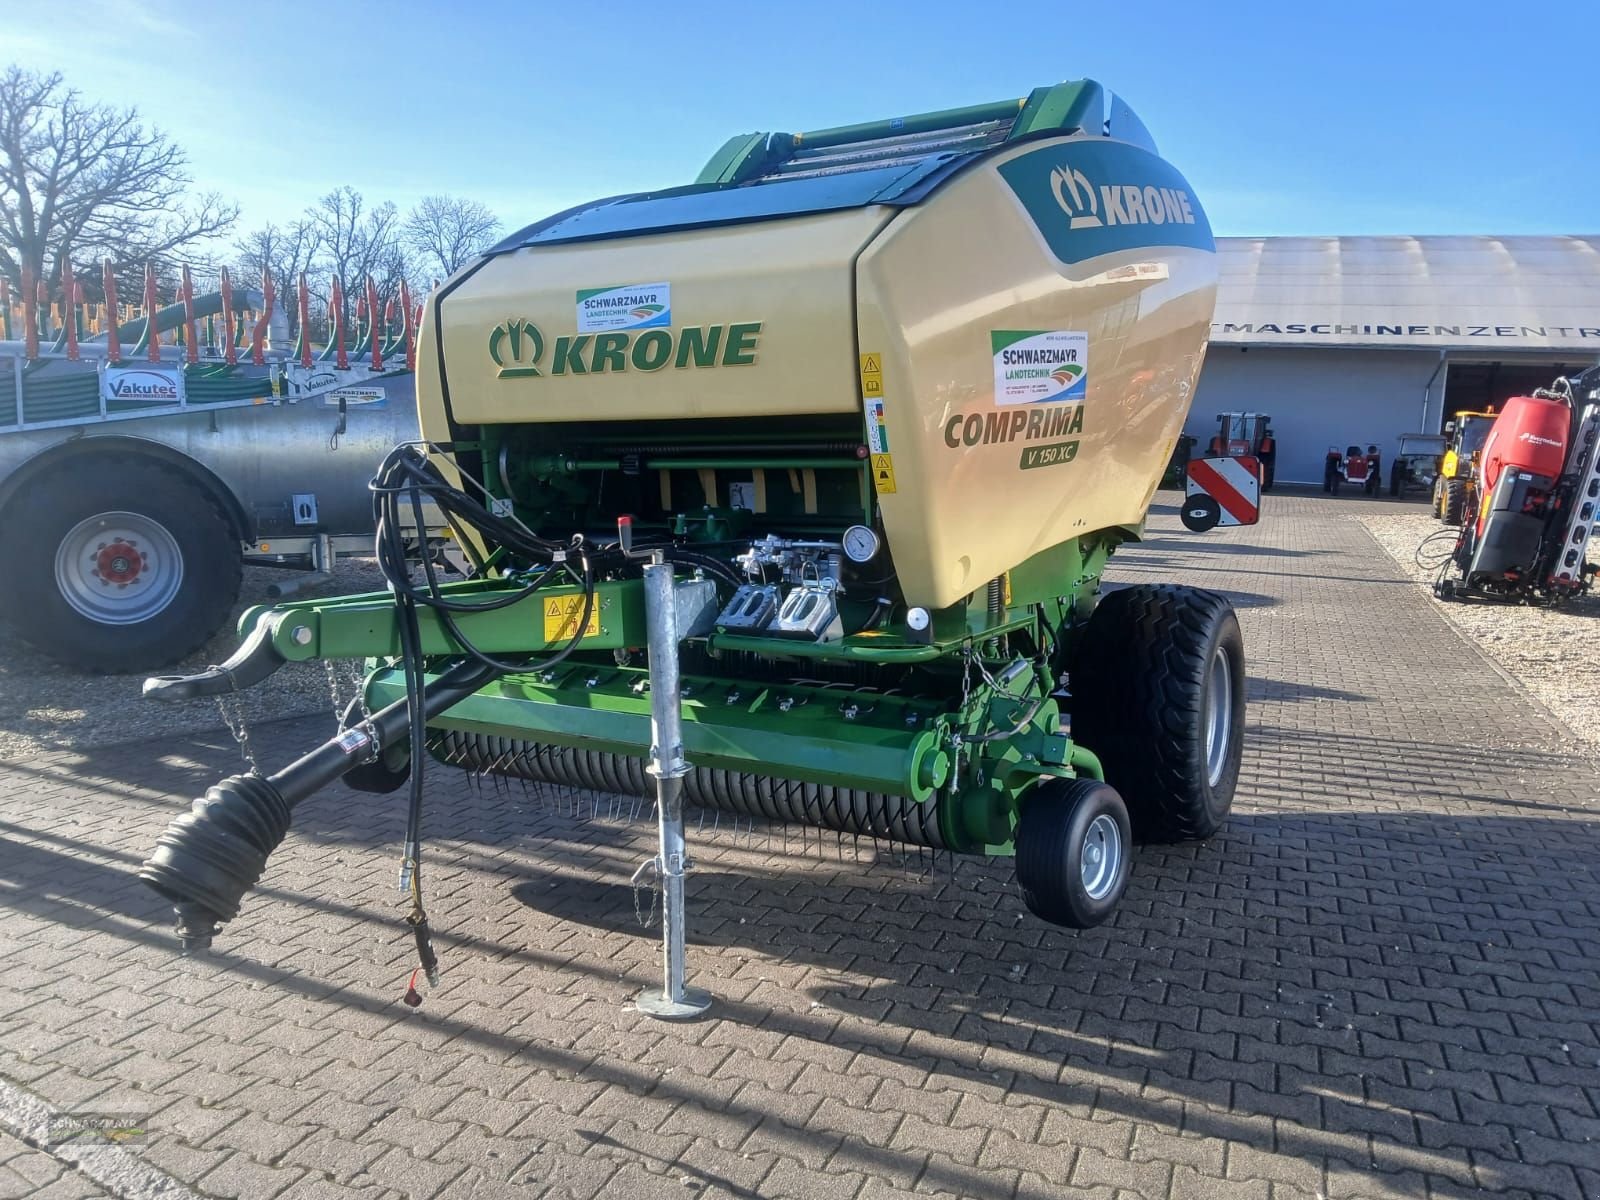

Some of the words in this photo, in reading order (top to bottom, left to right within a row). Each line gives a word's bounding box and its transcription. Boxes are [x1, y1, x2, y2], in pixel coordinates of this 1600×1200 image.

[1100, 185, 1195, 226] KRONE
[584, 294, 657, 310] SCHWARZMAYR
[586, 308, 628, 318] LANDTECHNIK
[551, 321, 762, 376] KRONE
[1003, 348, 1077, 365] SCHWARZMAYR
[1005, 368, 1050, 380] LANDTECHNIK
[108, 379, 177, 397] Vakutec
[304, 377, 337, 392] Vakutec
[944, 405, 1084, 449] COMPRIMA
[1028, 450, 1037, 465] V
[1039, 447, 1058, 464] 150
[1058, 445, 1074, 461] XC
